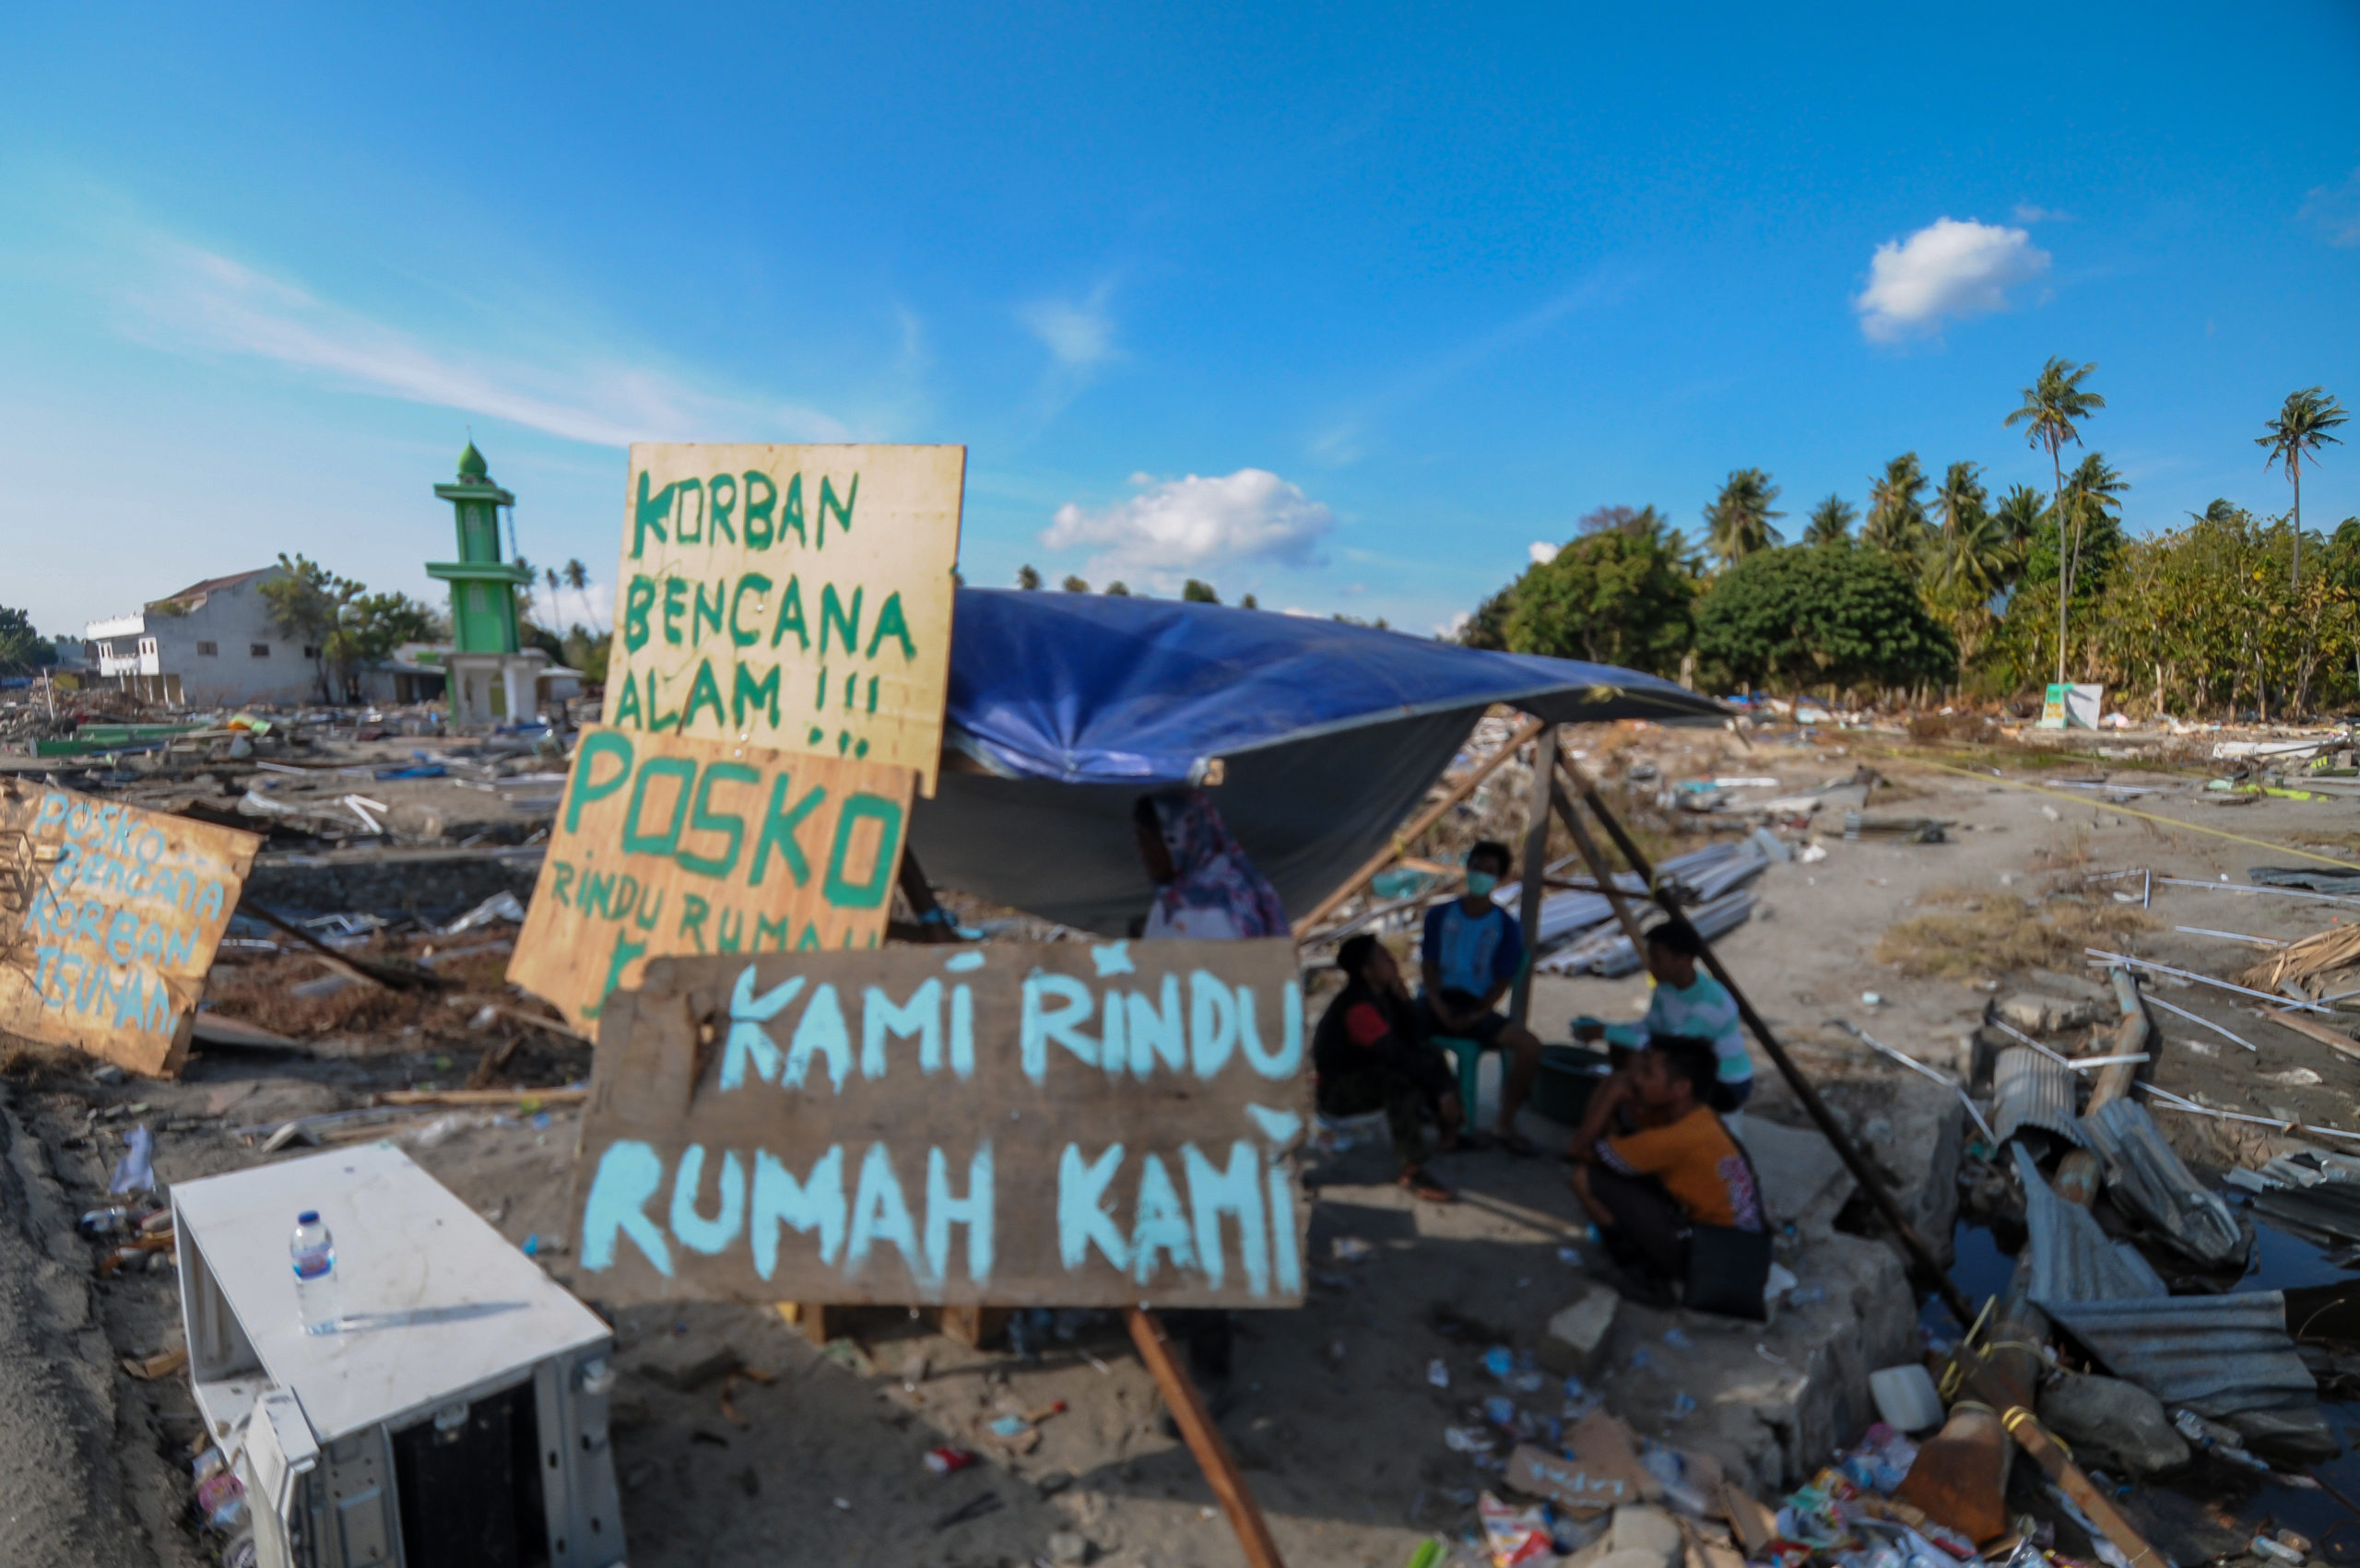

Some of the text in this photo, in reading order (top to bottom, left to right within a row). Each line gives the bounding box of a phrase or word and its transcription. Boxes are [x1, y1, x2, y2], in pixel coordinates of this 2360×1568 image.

[629, 470, 858, 560] KORBAN
[624, 572, 917, 662] BENCANA
[614, 657, 781, 733] ALAM
[32, 791, 166, 865] POSKO
[564, 729, 903, 909] POSKO
[23, 882, 200, 967] KORBAN
[551, 850, 663, 931] RINDU
[32, 946, 180, 1038] TSUNAMI
[719, 950, 985, 1094] KAMI
[1021, 938, 1301, 1089] RINDU
[580, 1102, 1302, 1297] RUMAH KAMI
